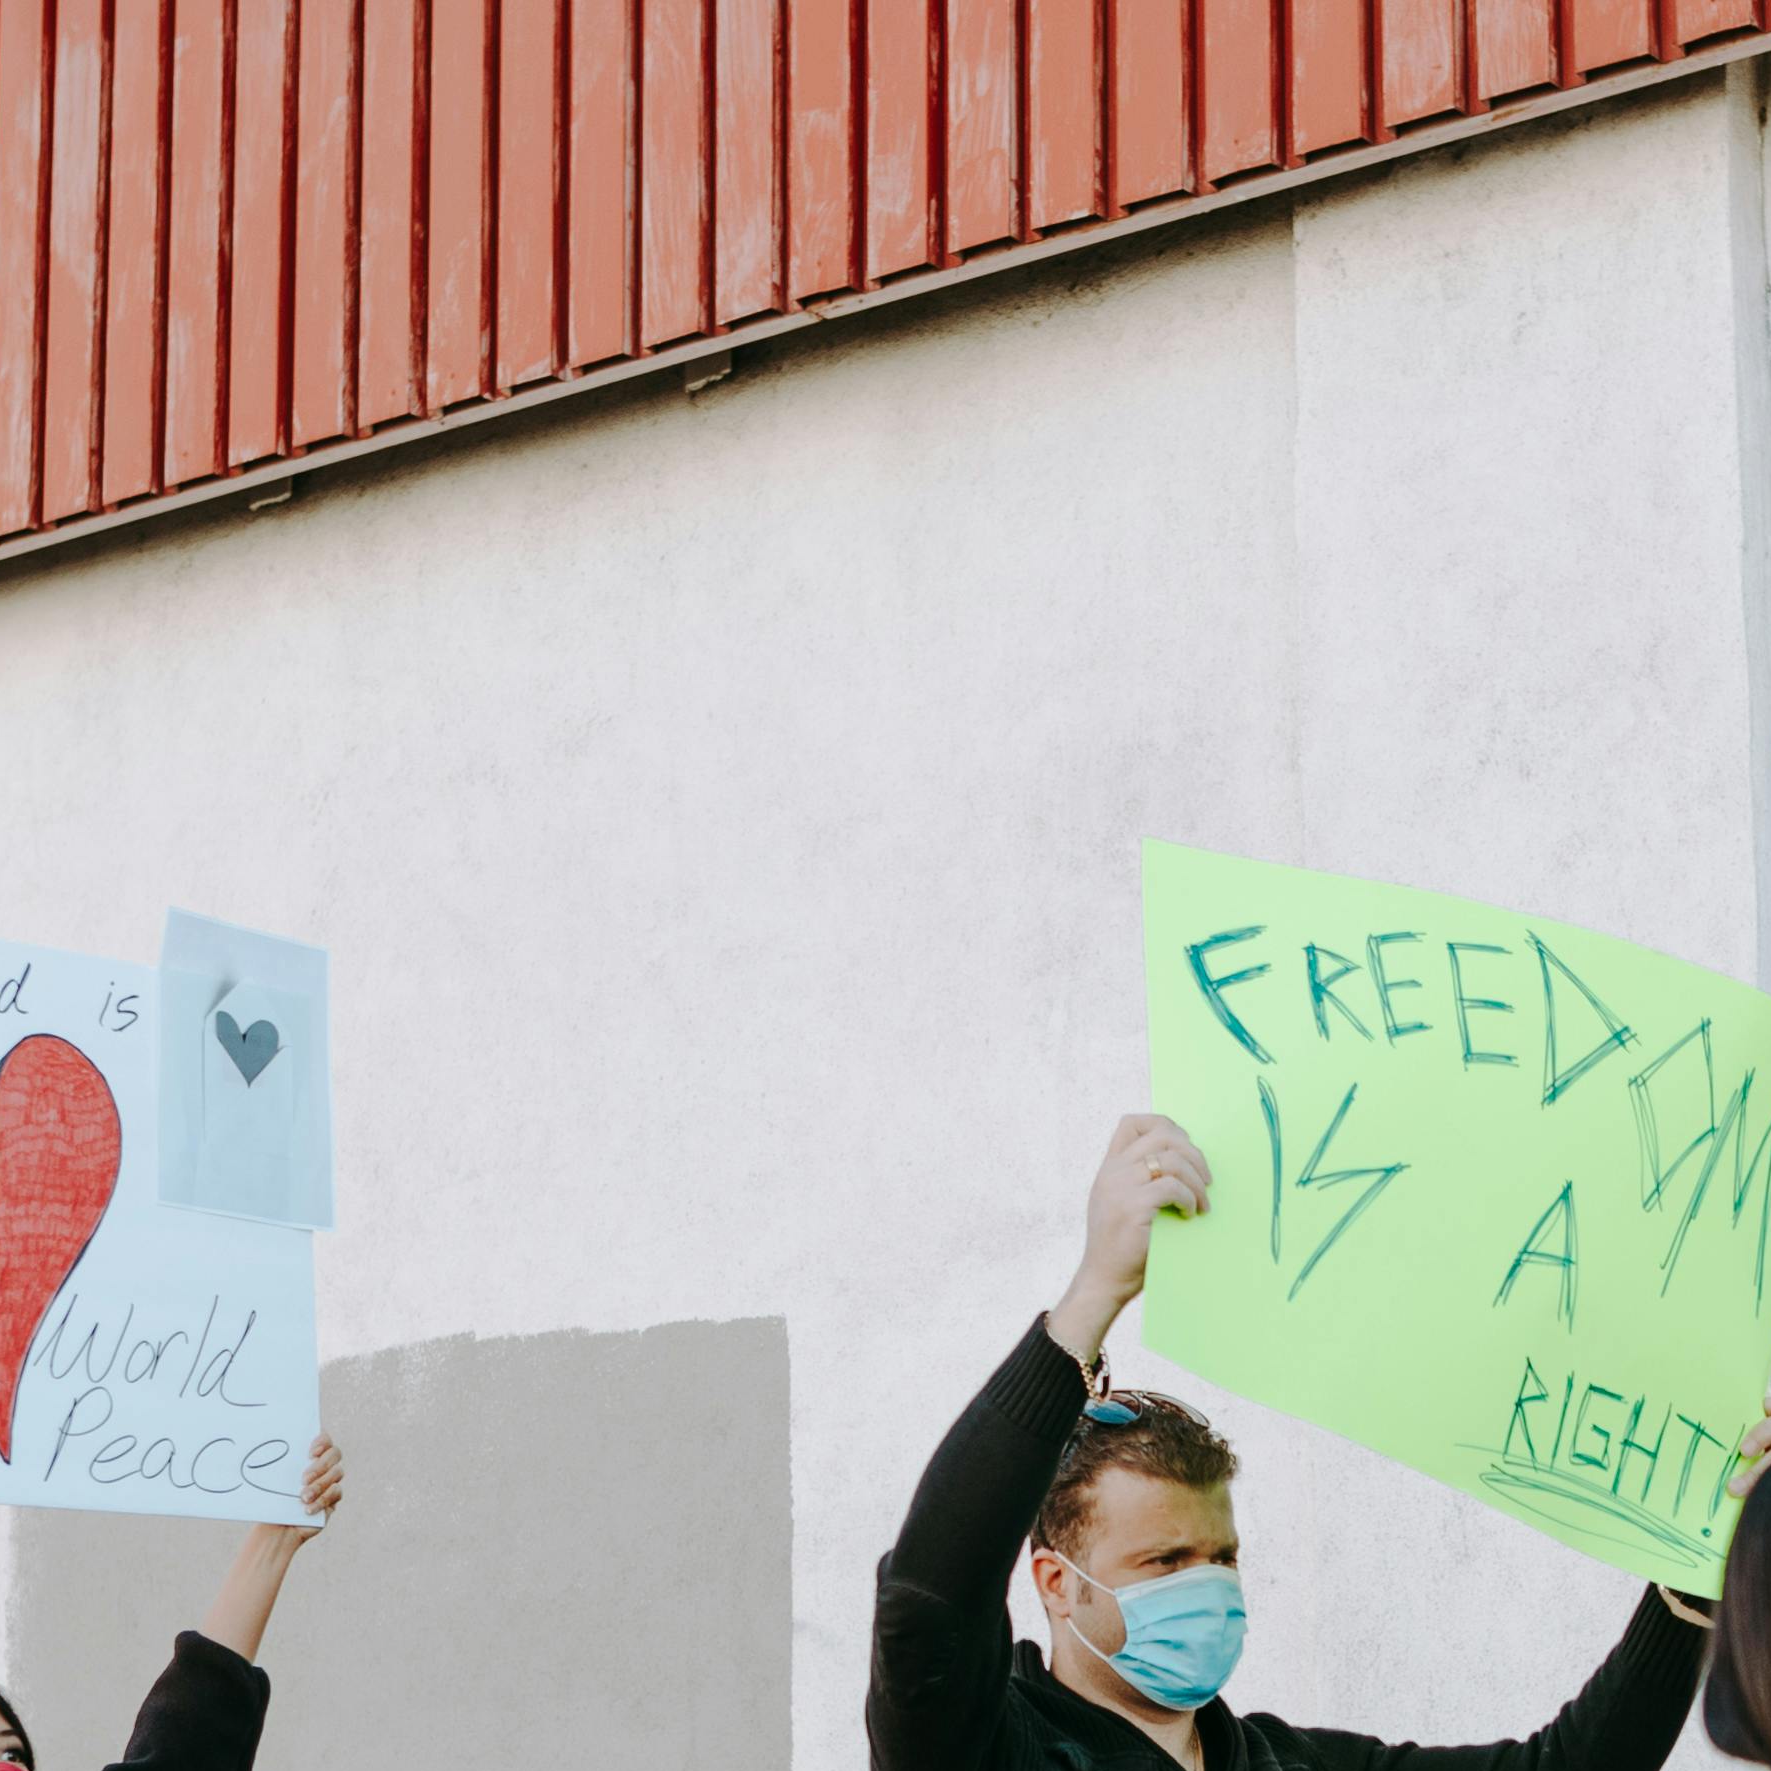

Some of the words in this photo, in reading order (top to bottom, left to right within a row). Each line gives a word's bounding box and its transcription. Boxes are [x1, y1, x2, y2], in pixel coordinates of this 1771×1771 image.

[99, 980, 139, 1033] is
[1256, 1075, 1411, 1302] IS
[1492, 1180, 1577, 1334] A
[35, 1293, 268, 1407] World
[45, 1385, 307, 1500] Peace
[1501, 1356, 1746, 1539] RIGHT!
